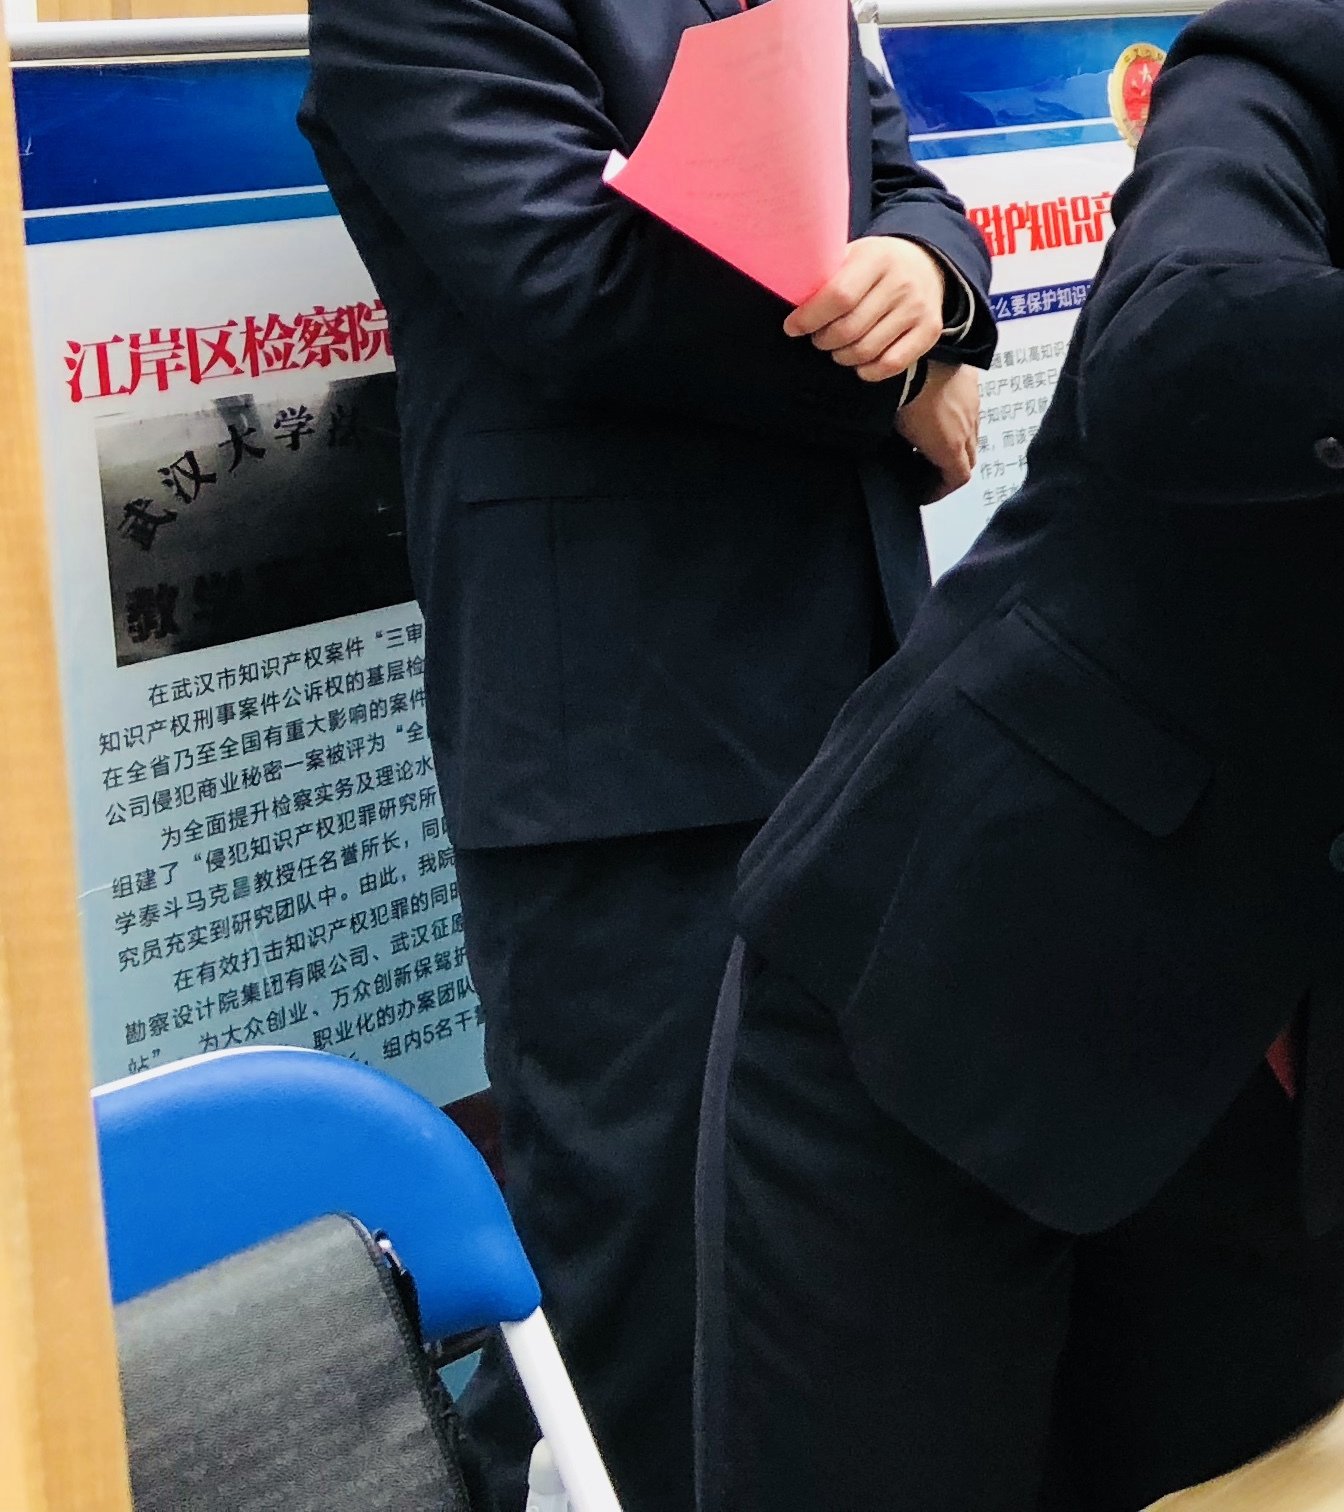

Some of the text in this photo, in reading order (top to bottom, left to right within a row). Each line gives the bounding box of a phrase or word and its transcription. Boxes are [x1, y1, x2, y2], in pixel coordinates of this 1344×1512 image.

[990, 284, 1091, 319] 么要保护知识
[105, 721, 430, 826] 公司侵犯商业秘密一案被评为“全
